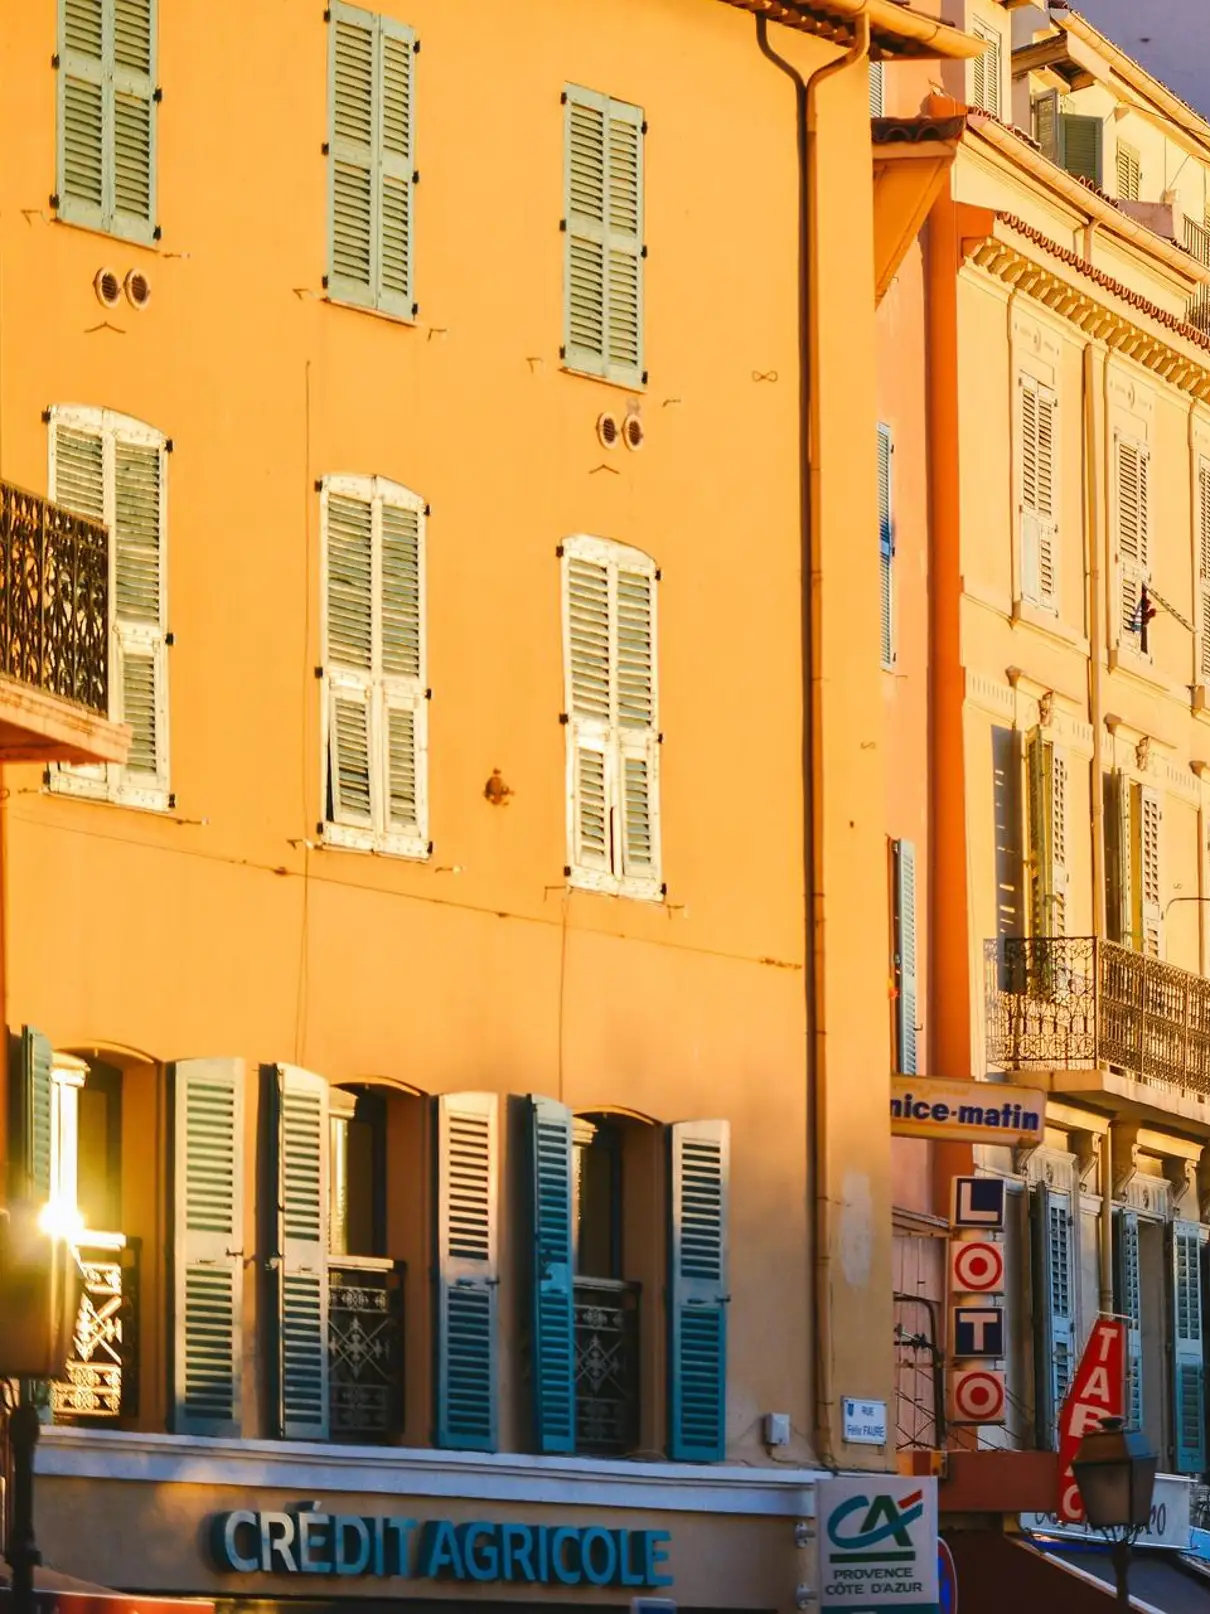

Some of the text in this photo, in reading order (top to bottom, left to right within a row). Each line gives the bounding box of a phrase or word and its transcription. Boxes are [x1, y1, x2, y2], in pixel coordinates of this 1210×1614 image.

[861, 1405, 875, 1417] RUE
[1062, 1327, 1118, 1520] TABC
[220, 1500, 675, 1588] CRÉDIT AGRICOLE
[833, 1567, 915, 1580] PROVENCE
[825, 1581, 923, 1595] CÔTE D'AZUR
